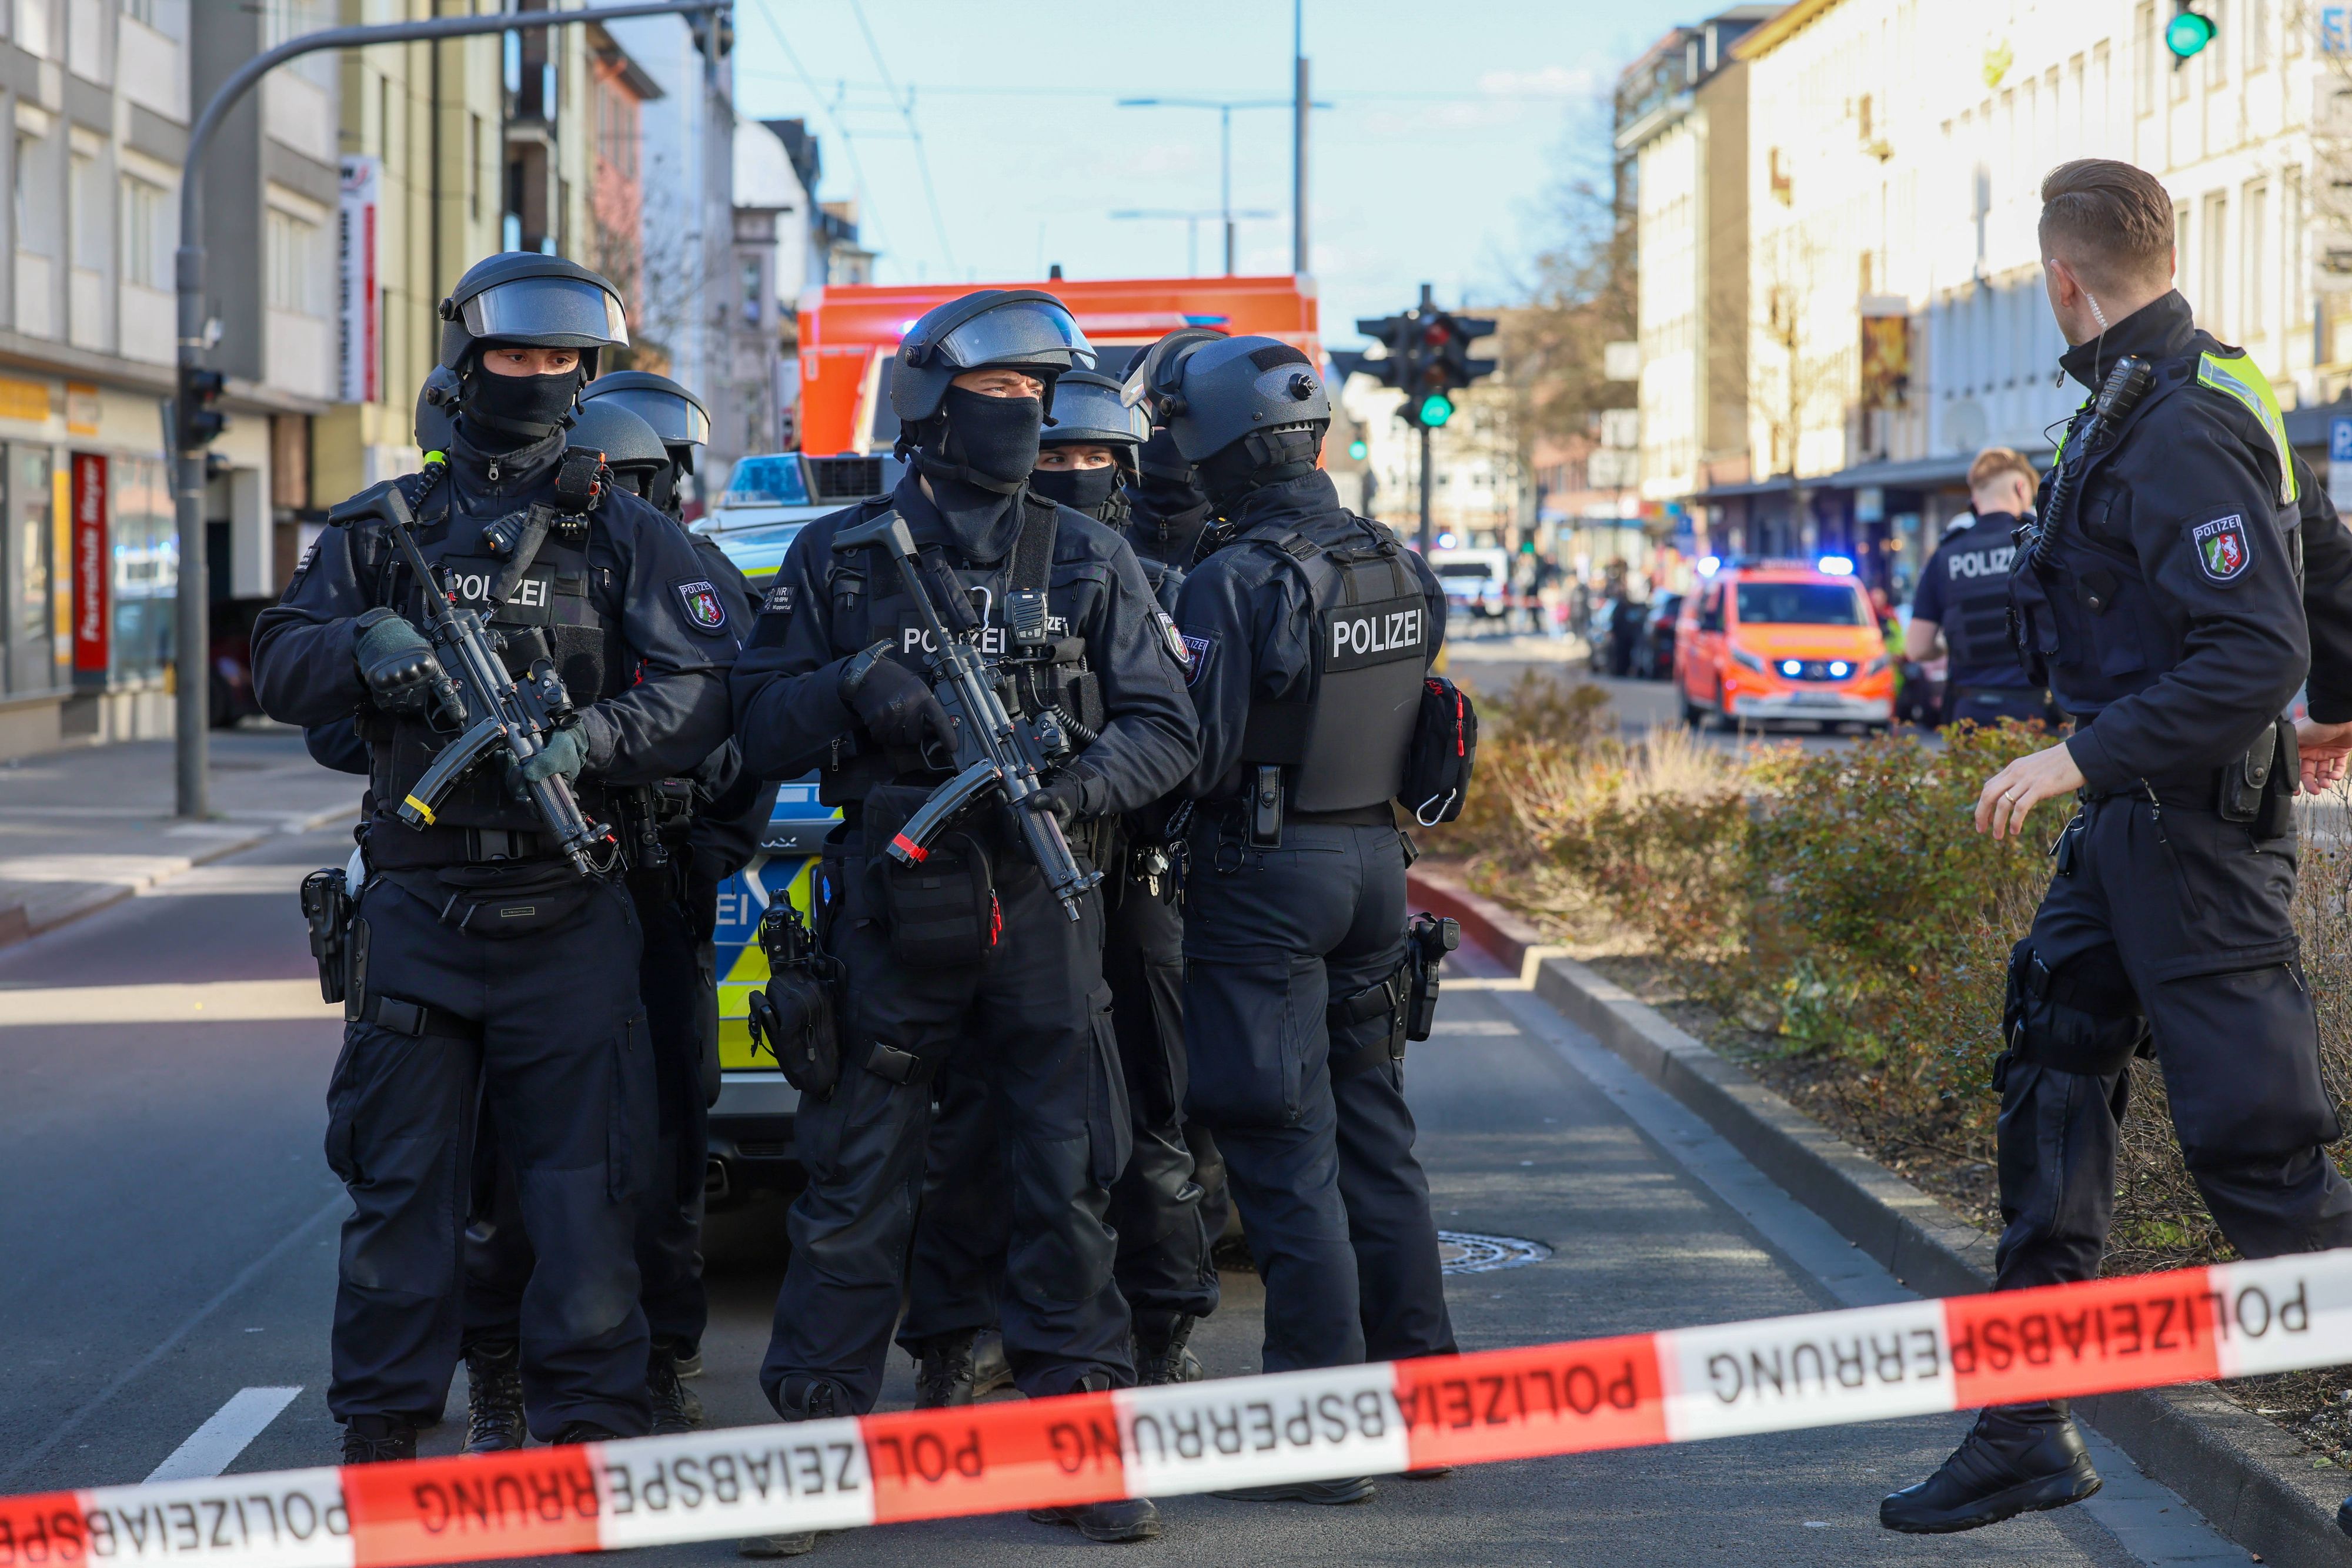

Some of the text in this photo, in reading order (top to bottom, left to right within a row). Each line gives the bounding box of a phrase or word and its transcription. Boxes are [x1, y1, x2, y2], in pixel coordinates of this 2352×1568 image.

[2196, 517, 2239, 540] POLIZEI
[776, 587, 794, 596] NRW
[1183, 638, 1206, 650] OLIZEI
[1333, 609, 1422, 658] POLIZEI
[1708, 1281, 2308, 1403] POLIZEIABSPERRUNG
[1050, 1362, 1637, 1473] POLIZEIABSPERRUNG
[414, 1427, 983, 1533] POLIZEIABSPERRUNG
